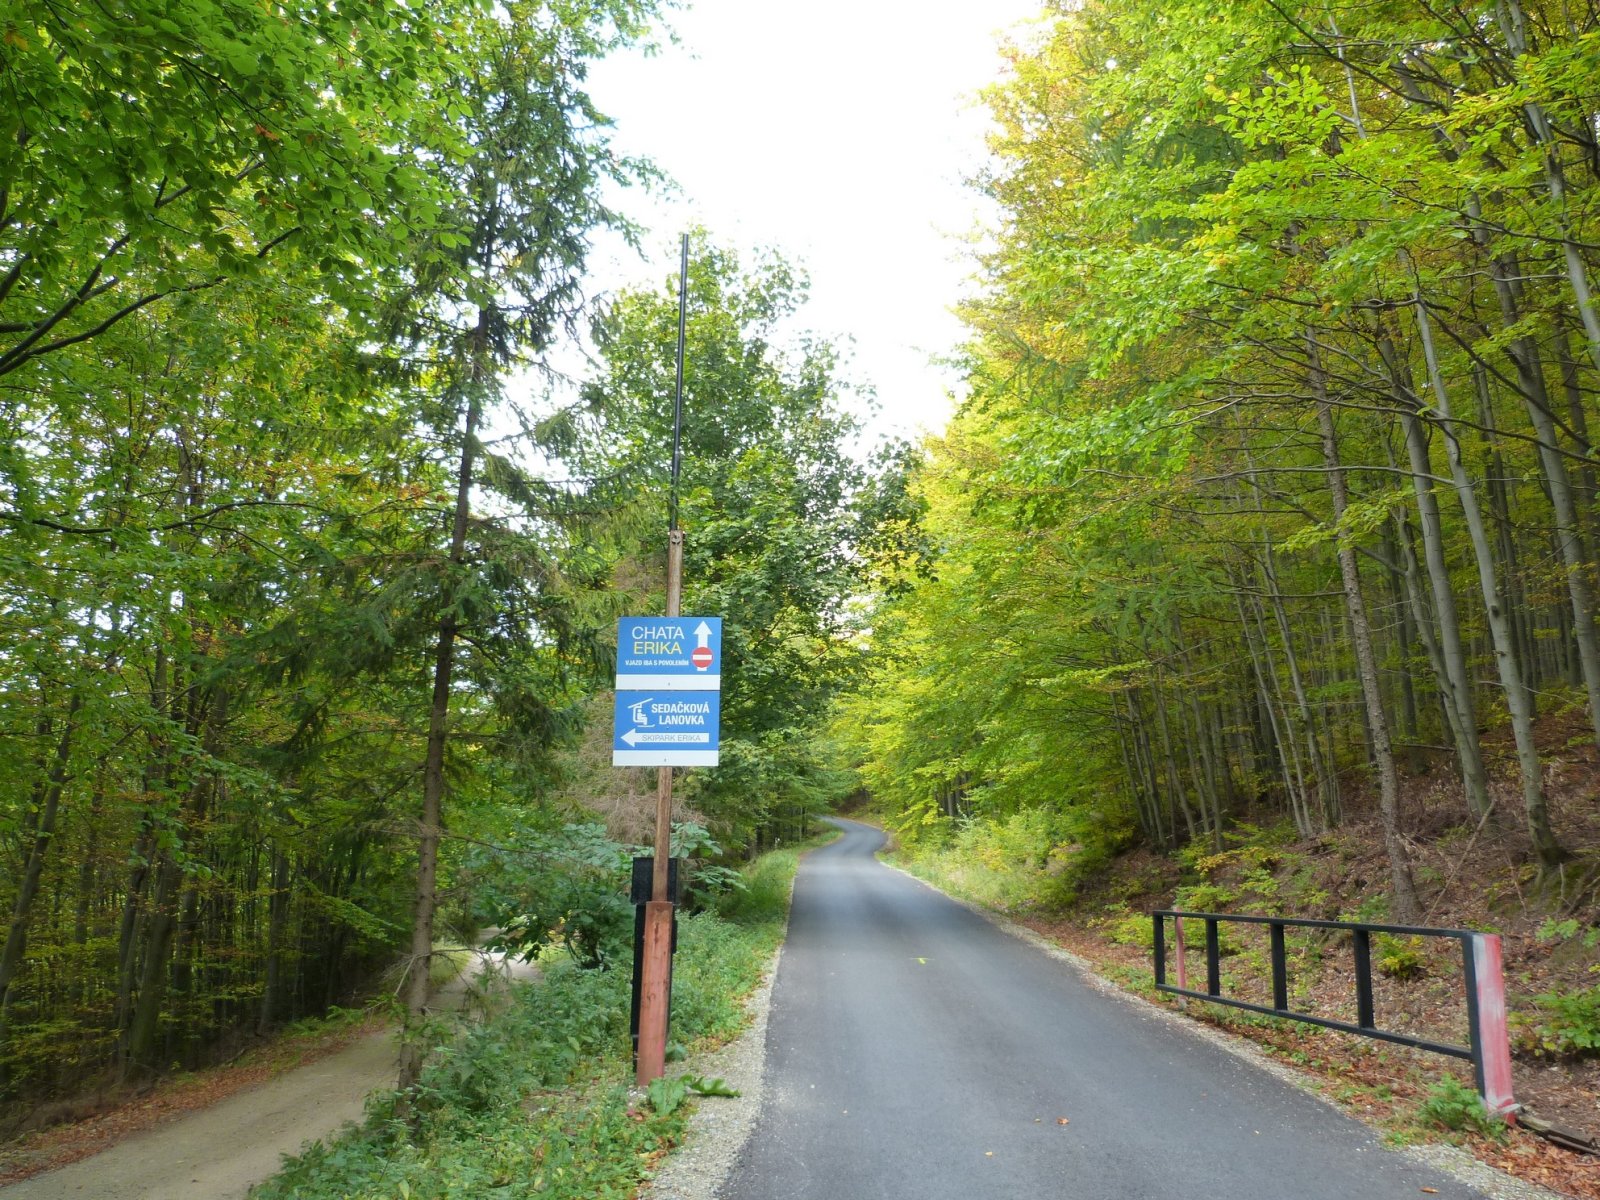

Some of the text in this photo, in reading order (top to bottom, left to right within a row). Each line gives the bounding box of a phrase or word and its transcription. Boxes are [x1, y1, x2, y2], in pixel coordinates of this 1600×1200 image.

[632, 626, 684, 640] CHATA
[634, 641, 682, 655] ERIKA
[651, 701, 710, 714] SEDAČKOVÁ
[659, 715, 705, 725] LANOVKA
[641, 734, 701, 742] SKIPARK ERIKA
